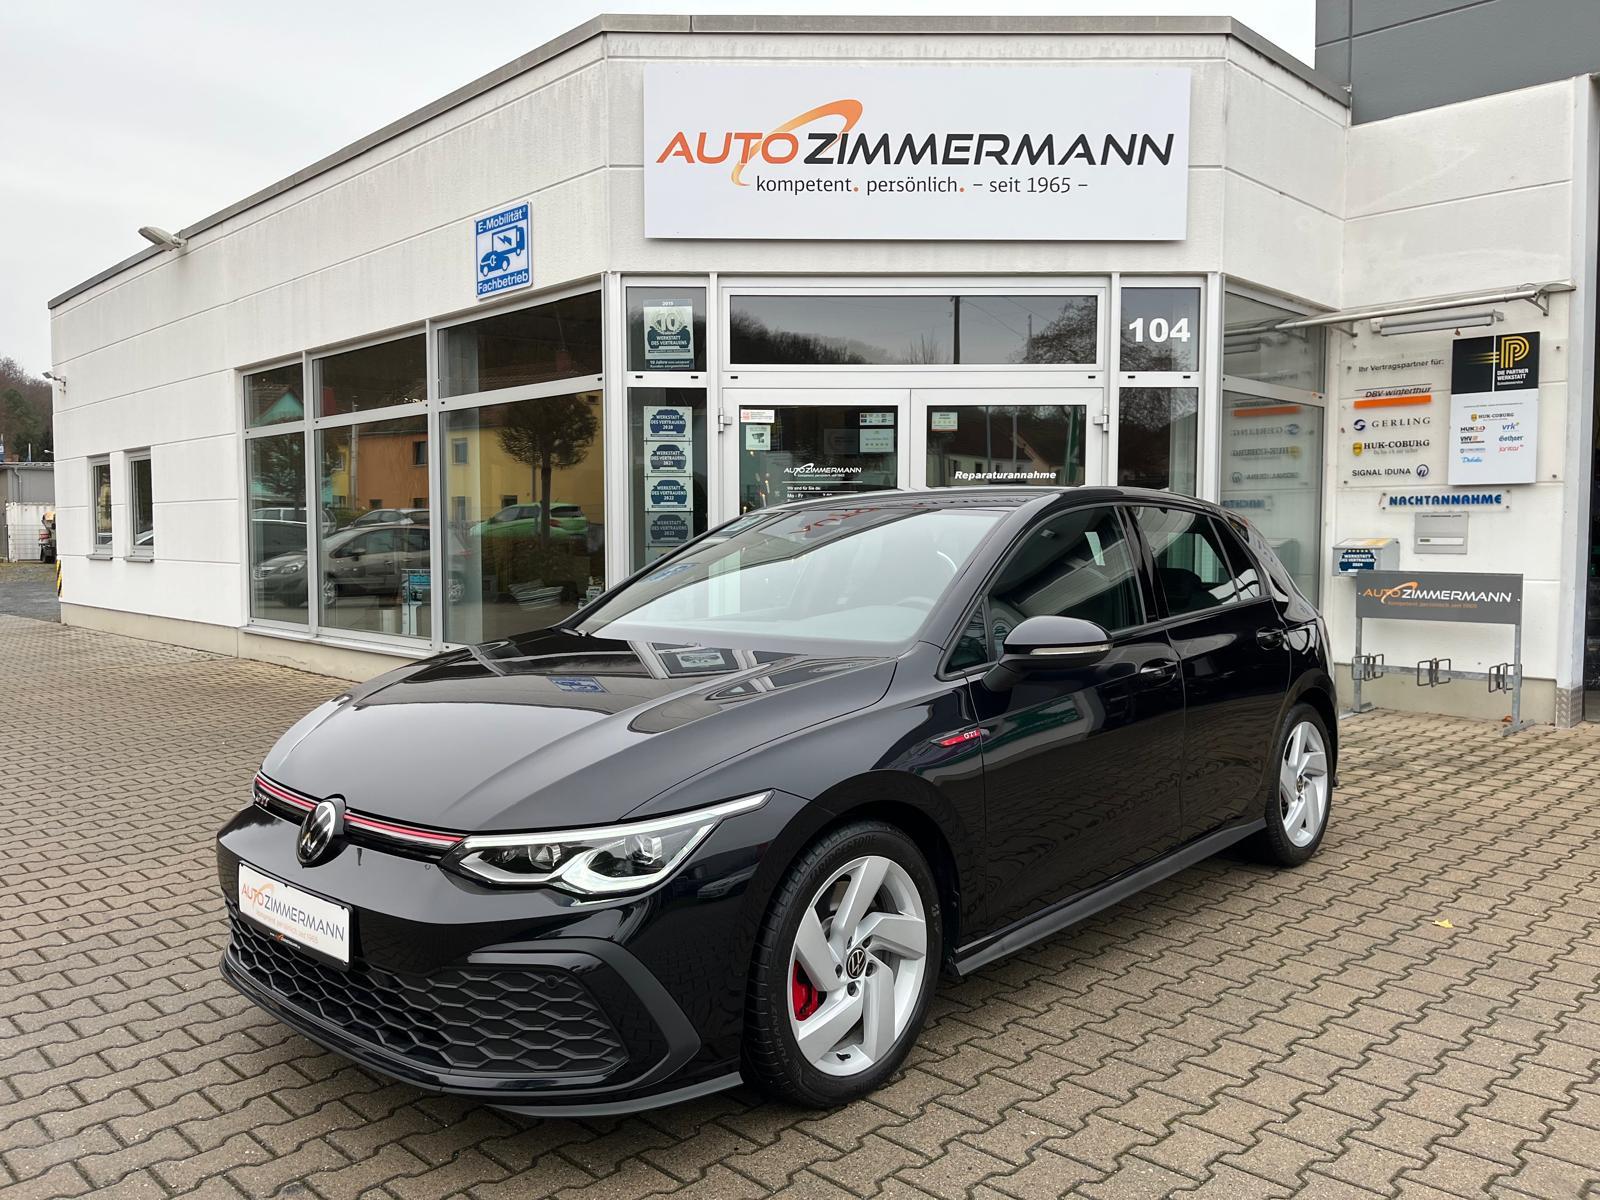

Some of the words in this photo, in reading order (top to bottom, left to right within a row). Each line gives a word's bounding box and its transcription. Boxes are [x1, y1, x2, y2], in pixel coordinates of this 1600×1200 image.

[656, 131, 800, 165] AUTO
[803, 132, 1175, 167] ZIMMERMANN
[756, 175, 859, 196] kompetent.
[866, 175, 966, 197] persönlich.
[989, 176, 1022, 194] seit
[1027, 176, 1071, 194] 1965
[478, 271, 529, 293] Fachbetrieb
[1129, 318, 1191, 343] 104
[1370, 360, 1429, 372] Vertragspartner
[1371, 417, 1431, 428] GERLING
[1363, 440, 1430, 450] HUK-COBURG
[954, 471, 1057, 481] Reparaturannahme
[1352, 468, 1382, 476] SIGNAL
[1384, 467, 1411, 476] IDUNA
[1389, 494, 1502, 506] NACHTANNAHME
[1362, 588, 1401, 599] AUTO
[1402, 589, 1512, 603] ZIMMERMANN
[964, 730, 978, 740] GTI
[242, 883, 265, 907] AUTO
[264, 894, 345, 942] ZIMMERMANN
